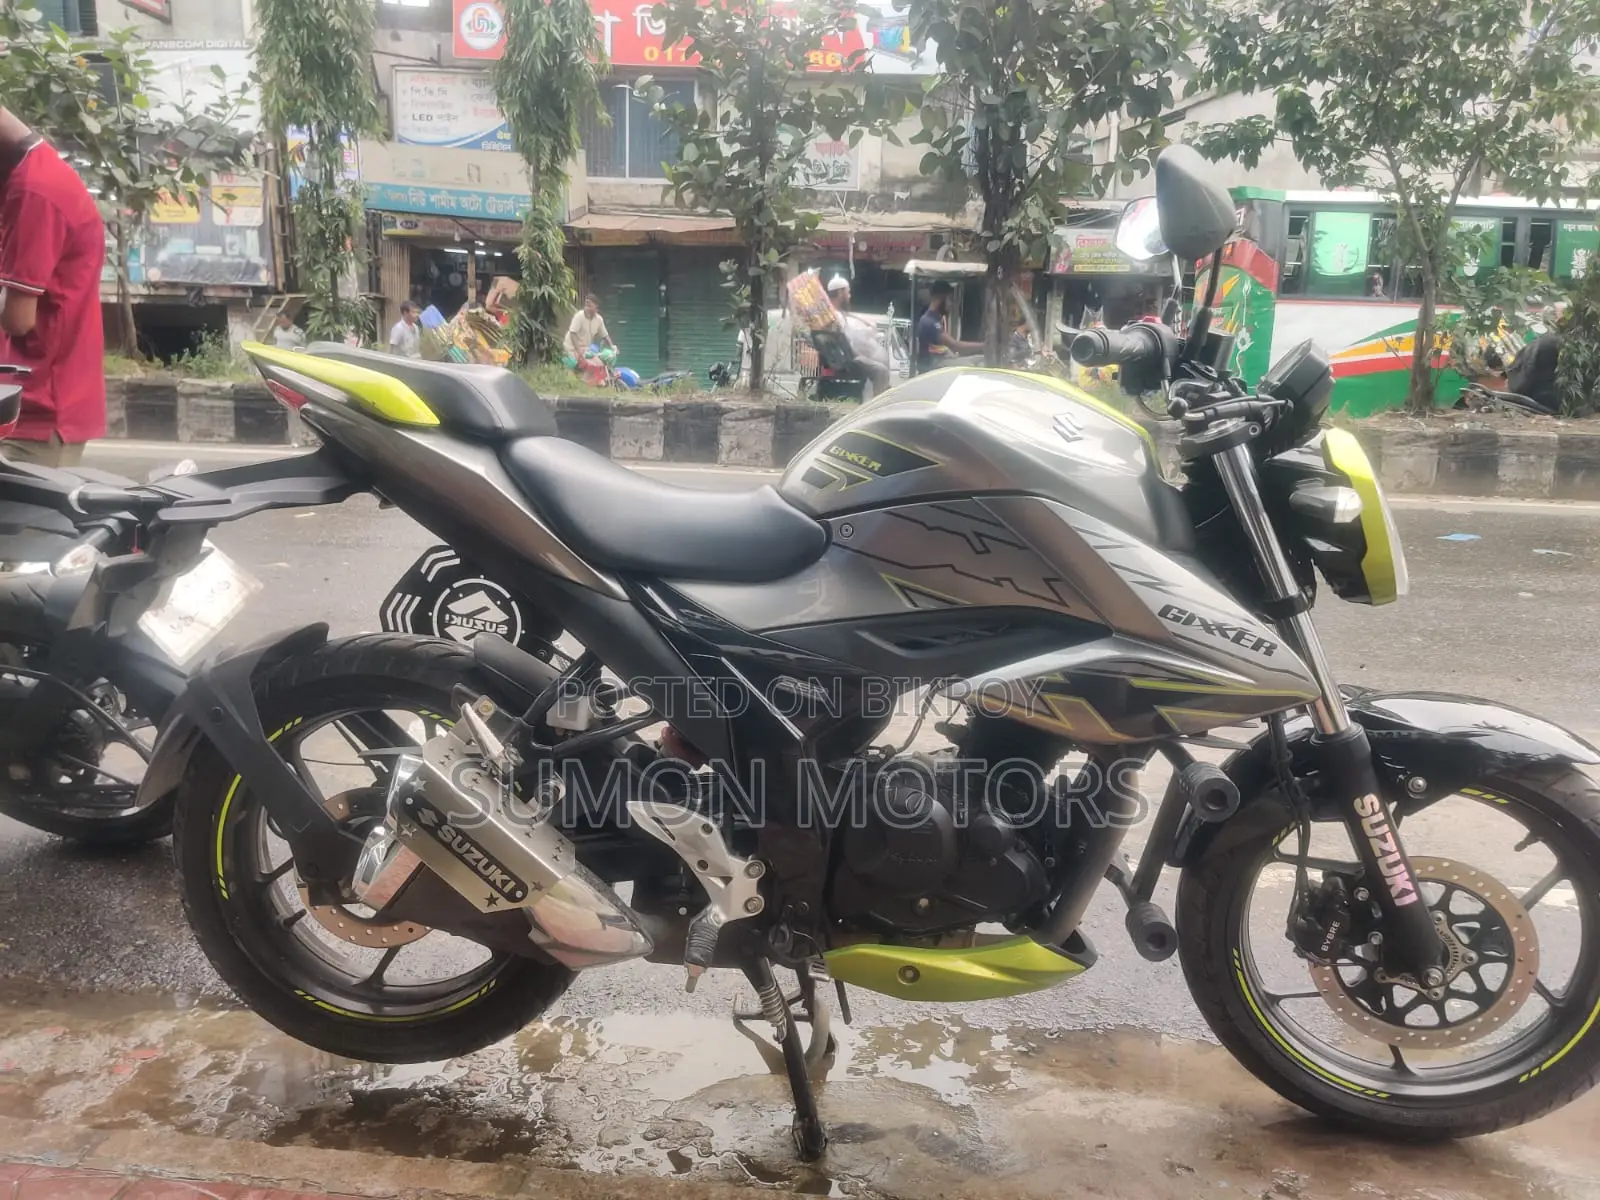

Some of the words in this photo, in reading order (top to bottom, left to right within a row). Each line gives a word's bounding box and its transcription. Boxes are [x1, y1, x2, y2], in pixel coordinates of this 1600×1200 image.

[206, 38, 250, 49] DIGITAL
[412, 113, 434, 121] LED
[1157, 604, 1278, 657] GIXXER
[437, 823, 517, 894] SUZUKI
[1353, 793, 1419, 907] SUZUKI
[1320, 920, 1341, 952] BYBRE
